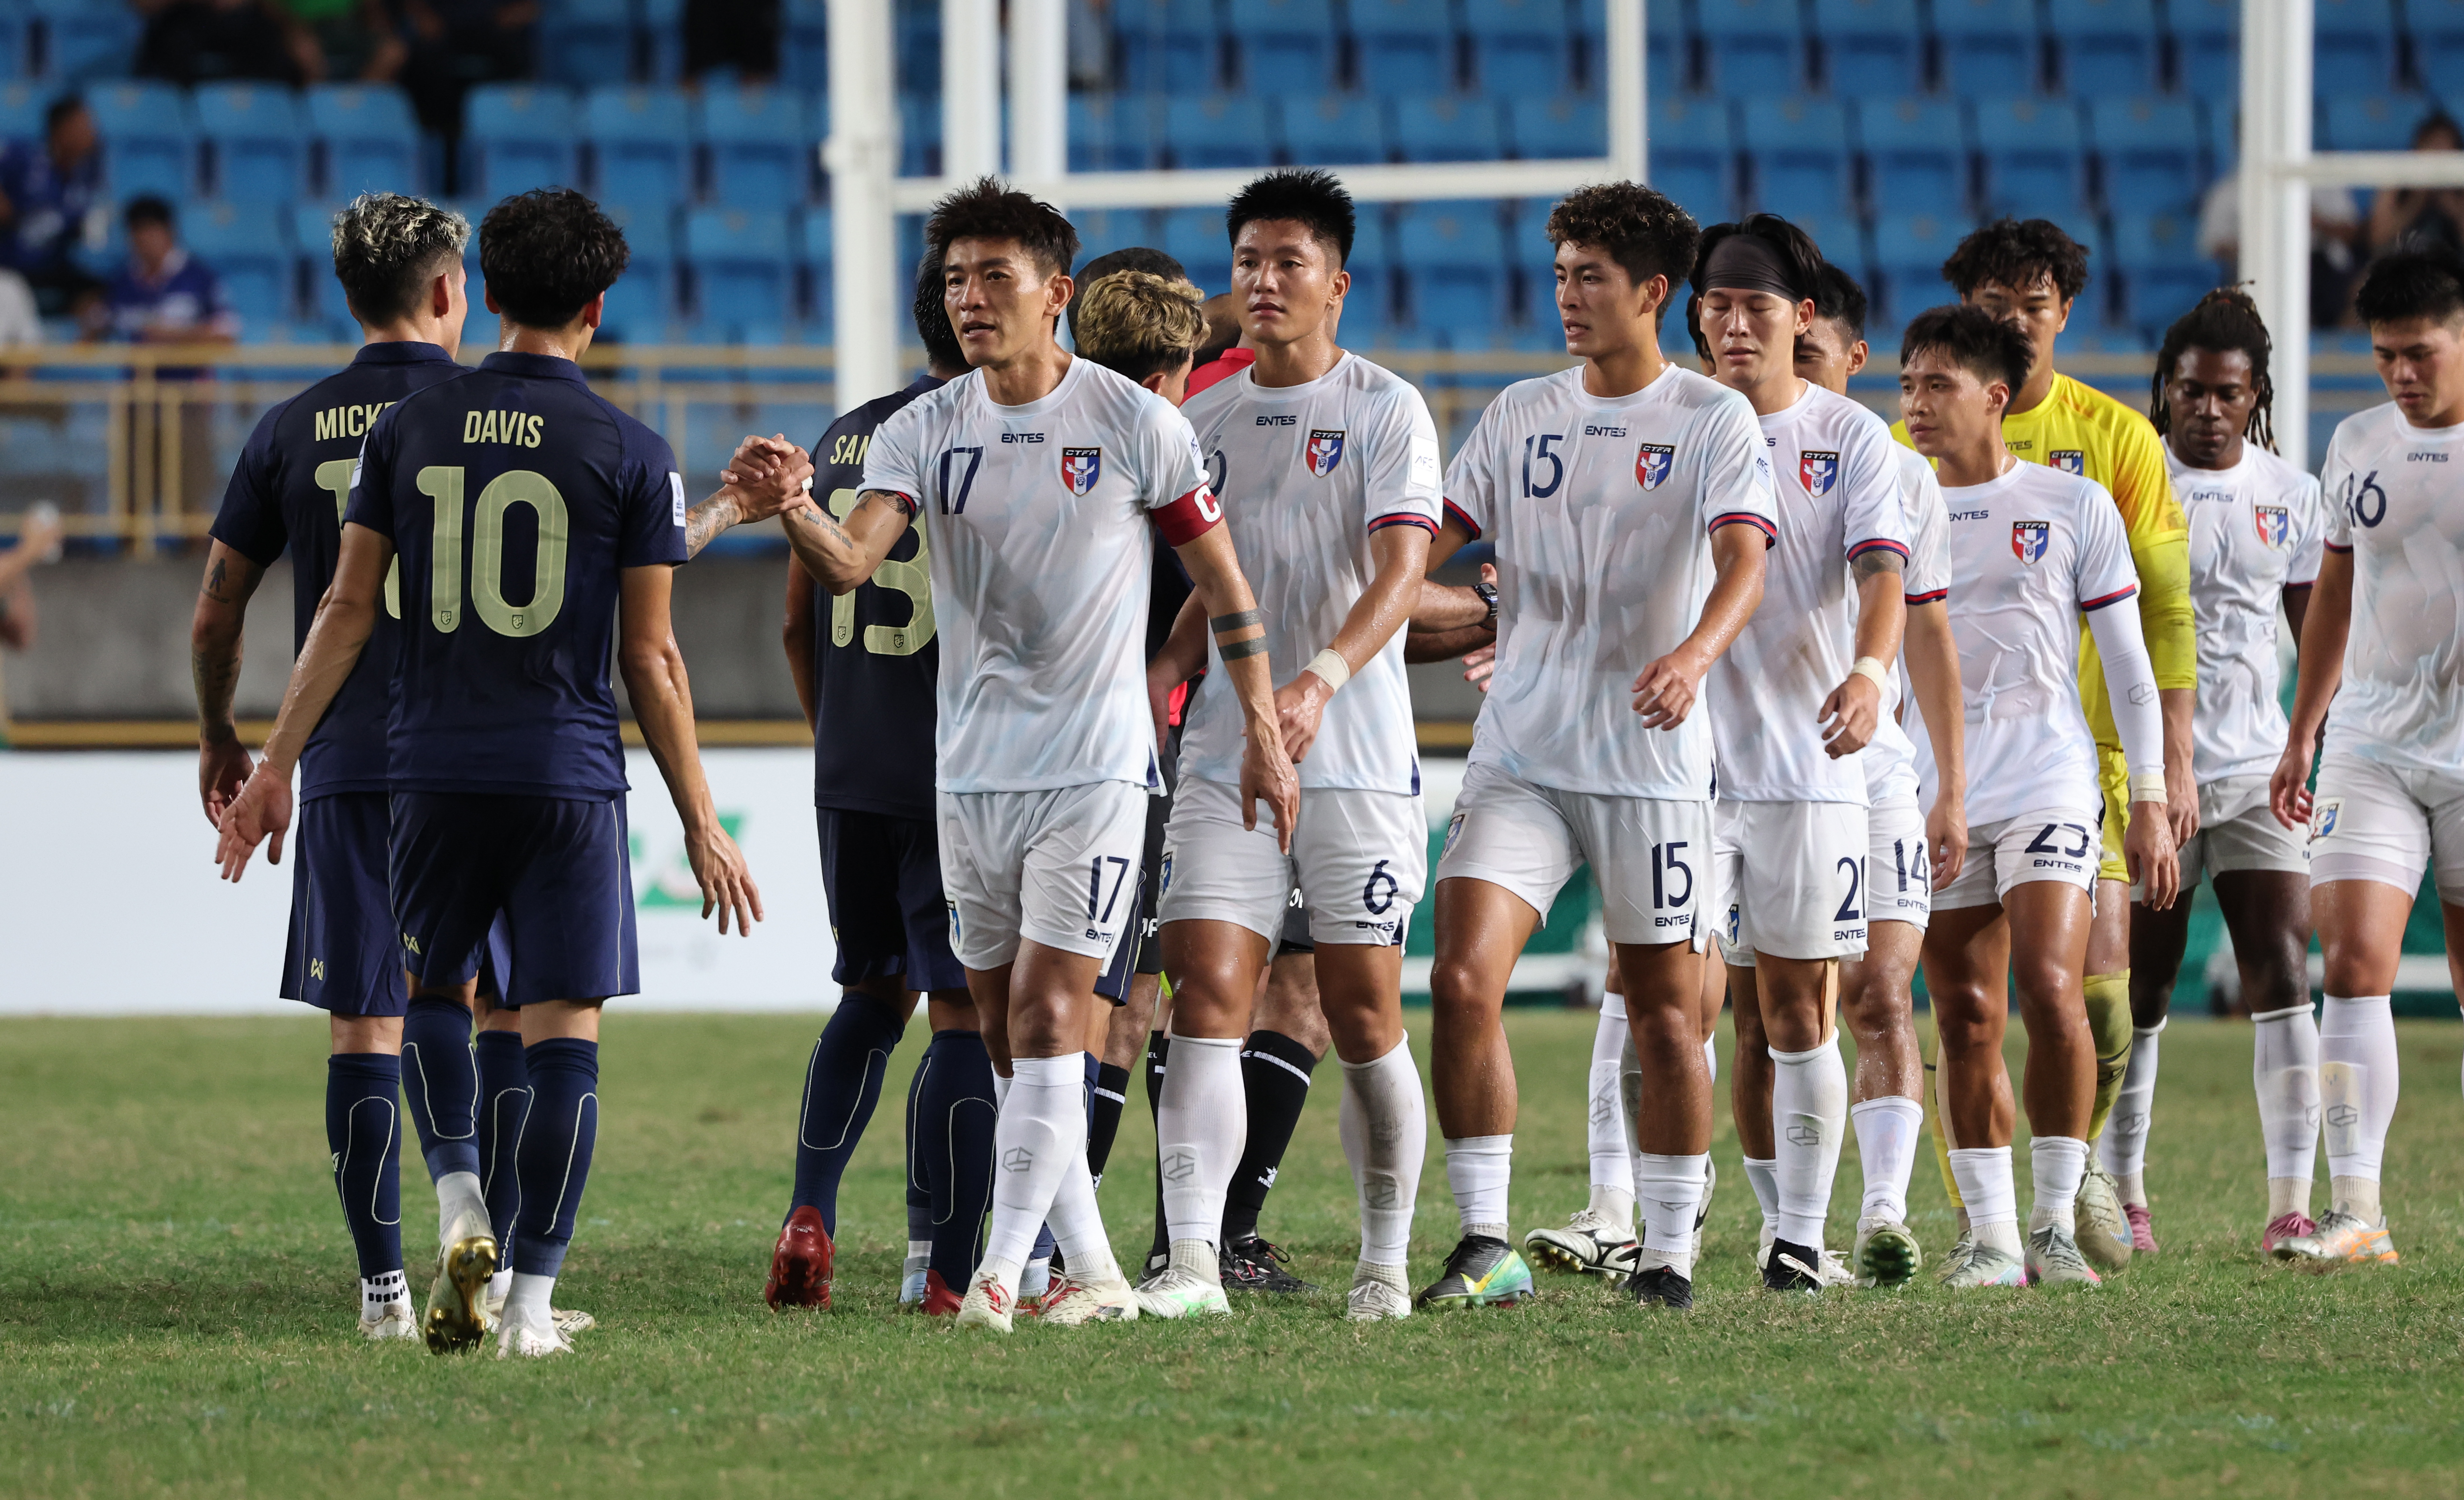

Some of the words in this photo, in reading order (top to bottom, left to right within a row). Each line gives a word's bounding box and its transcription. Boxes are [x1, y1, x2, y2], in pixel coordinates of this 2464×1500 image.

[315, 401, 398, 441] MICK
[464, 410, 544, 449] DAVIS
[1001, 433, 1044, 443] ENTES
[1256, 415, 1296, 426] ENTES
[1585, 425, 1626, 437] ENTES
[1414, 455, 1433, 469] AFC
[1522, 435, 1563, 498] 15
[2407, 453, 2448, 463] ENTES
[940, 446, 984, 515] 17
[2346, 470, 2386, 528] 16
[1194, 485, 1221, 522] C
[417, 466, 568, 637] 10
[1652, 841, 1692, 909] 15
[1894, 838, 1928, 898] 14
[2034, 859, 2083, 873] ENTES
[1088, 855, 1130, 924] 17
[1363, 860, 1398, 915] 6
[1834, 854, 1866, 921] 21
[1898, 899, 1928, 914] ENTES
[1655, 914, 1689, 927] ENTES
[1834, 928, 1866, 941] ENTES
